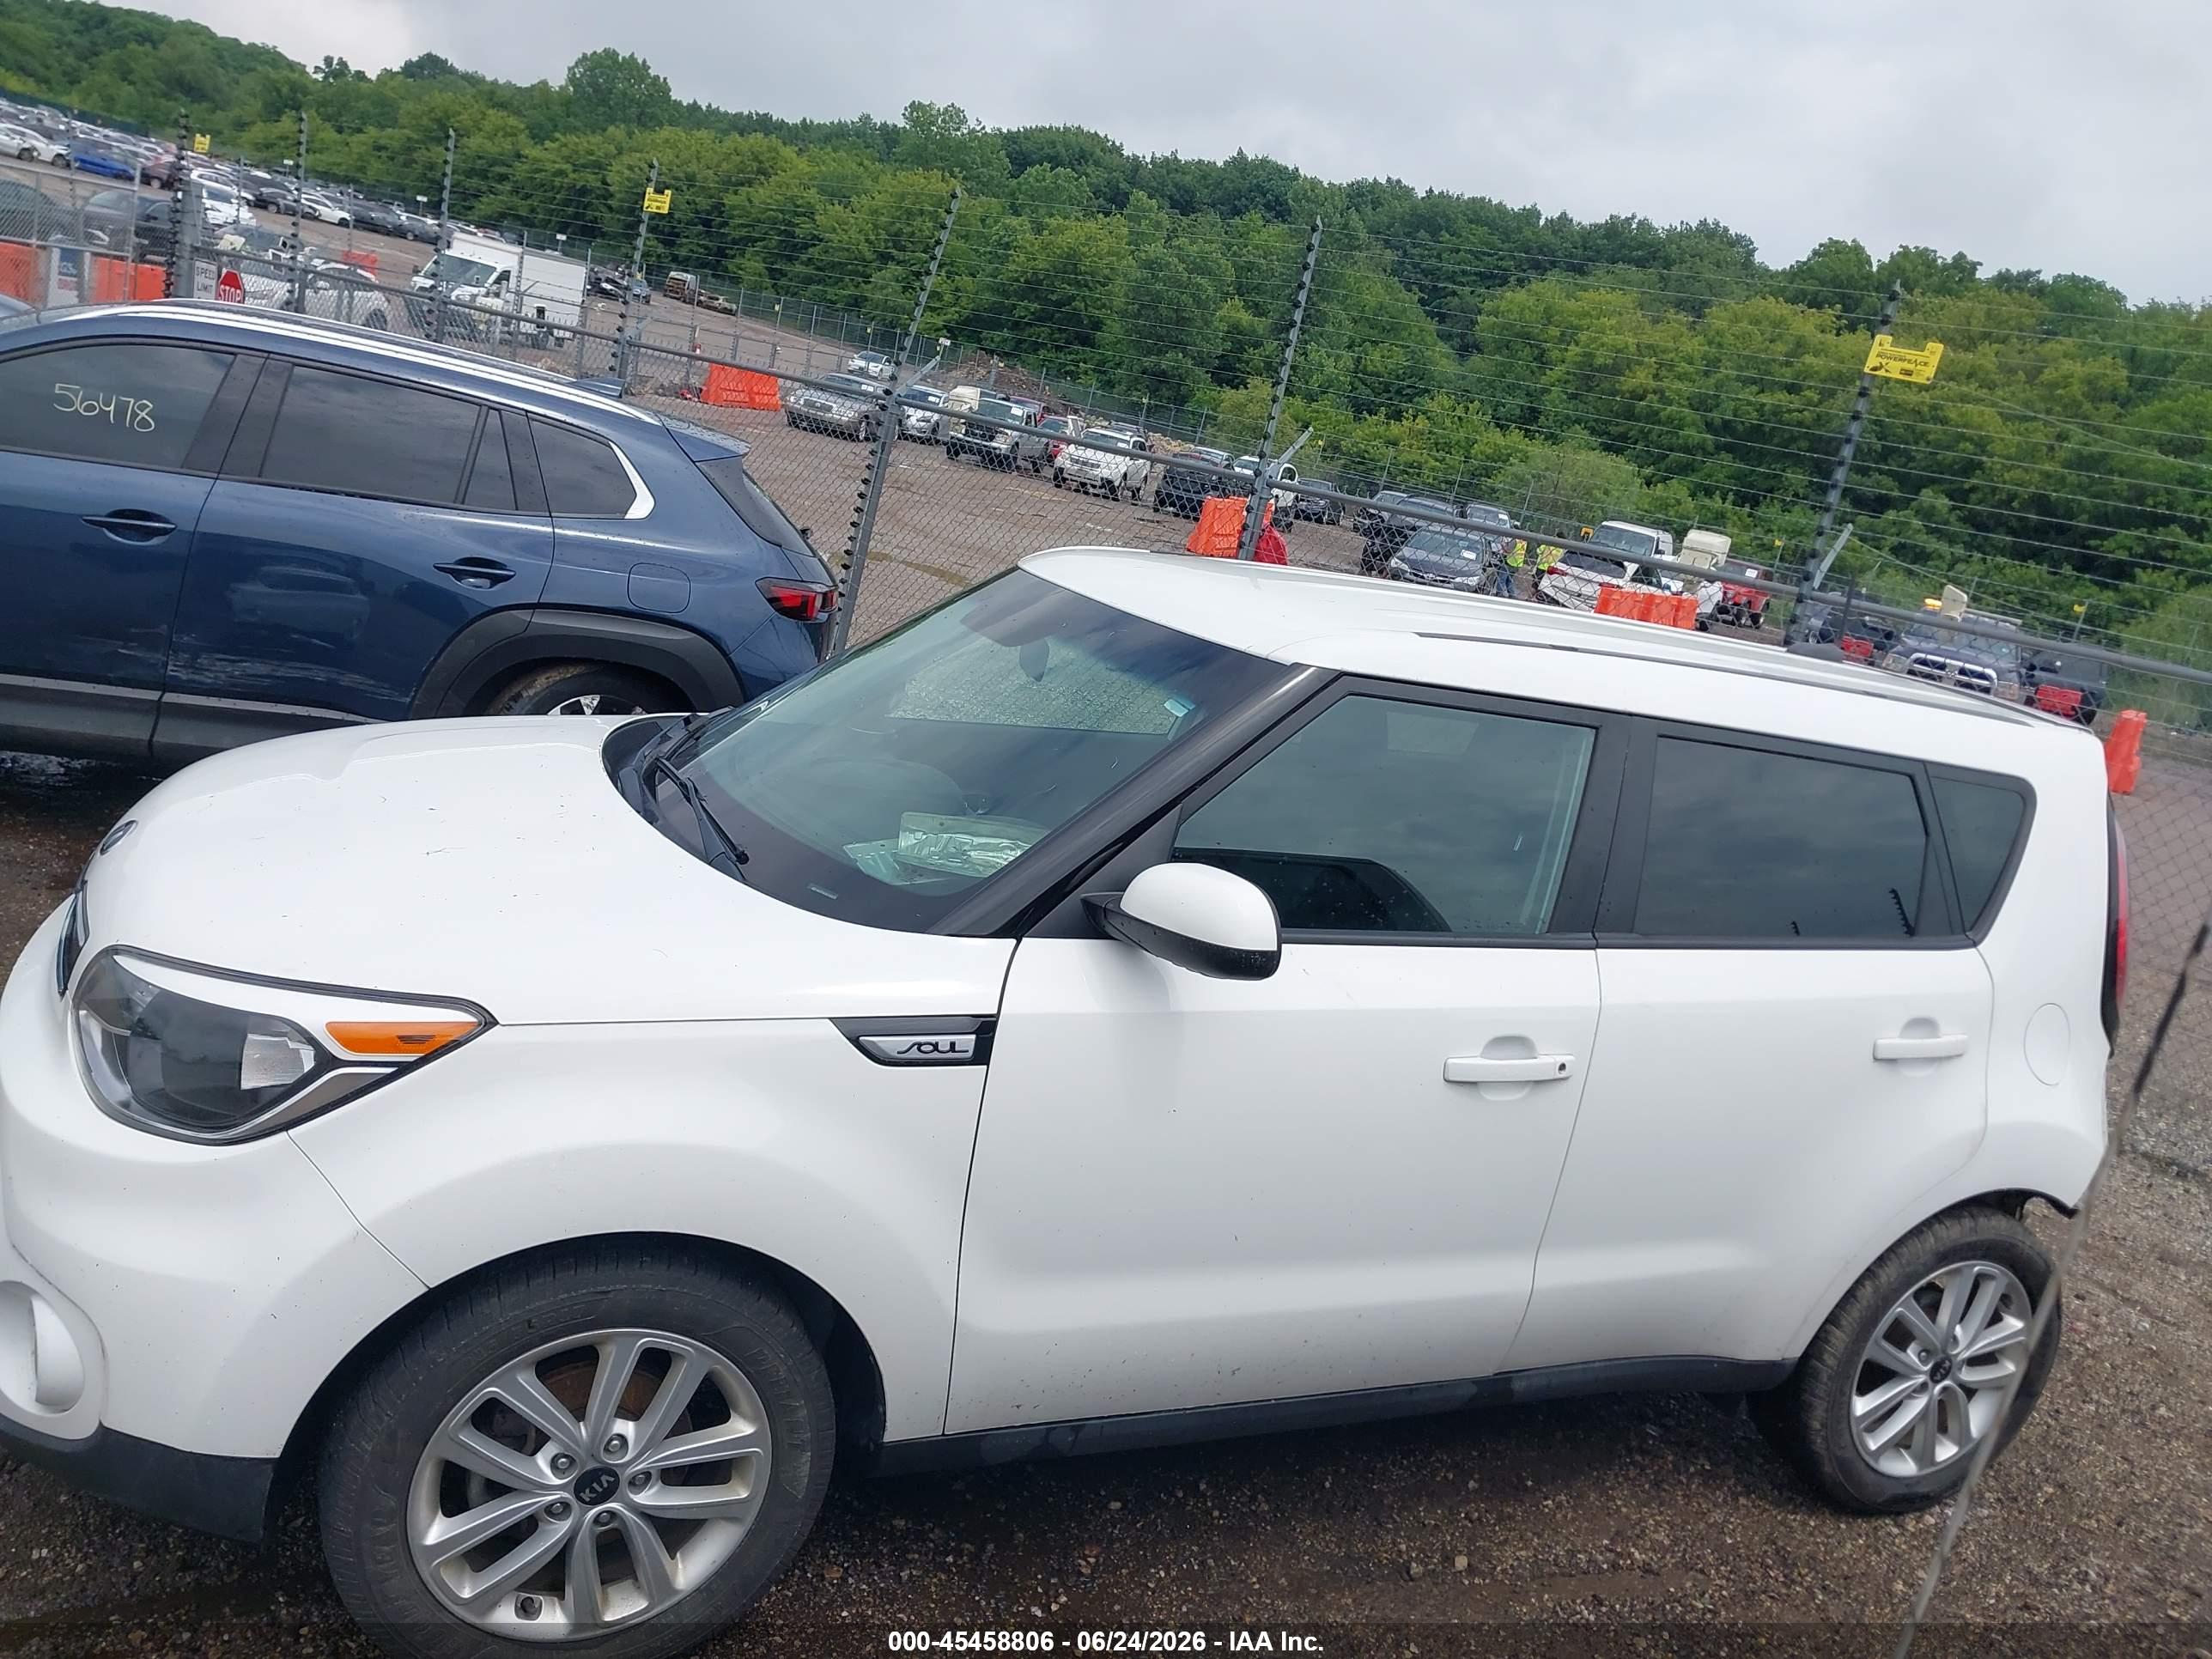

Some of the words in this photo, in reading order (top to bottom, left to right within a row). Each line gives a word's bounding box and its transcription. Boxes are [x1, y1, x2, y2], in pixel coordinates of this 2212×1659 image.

[196, 266, 215, 280] SPEED
[197, 281, 214, 295] LIMIT
[219, 284, 241, 302] STOP
[53, 383, 155, 432] 56478
[896, 1041, 969, 1054] SOUL
[579, 1474, 616, 1503] KIA
